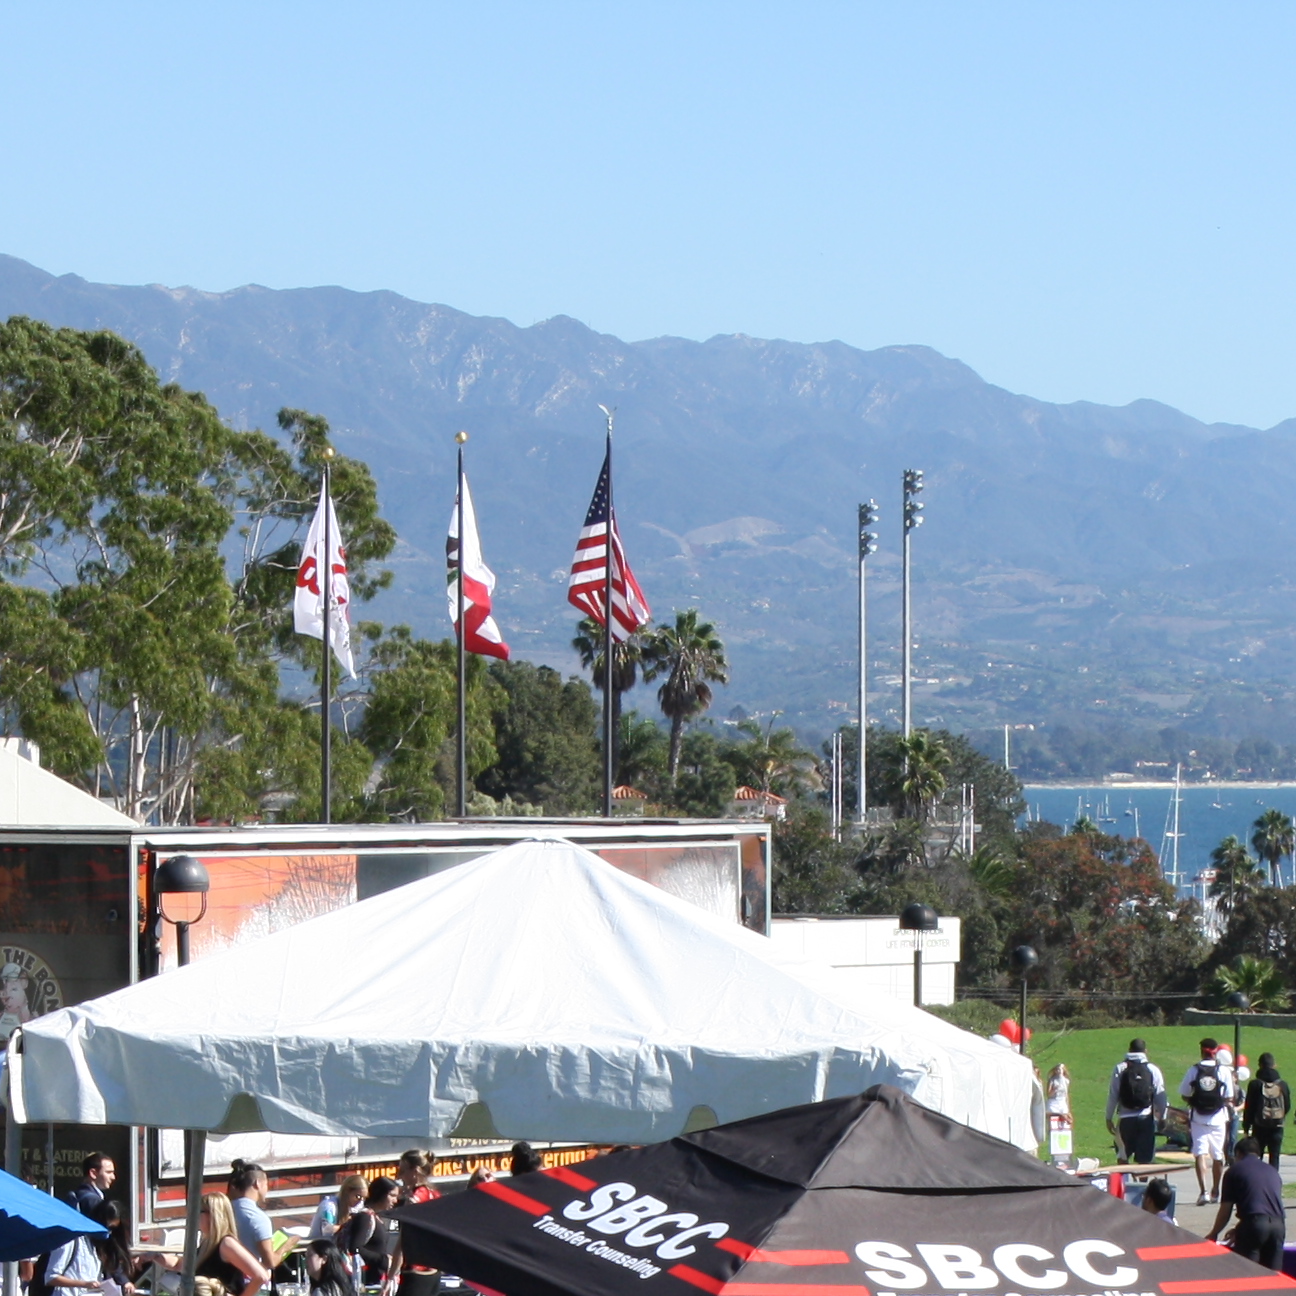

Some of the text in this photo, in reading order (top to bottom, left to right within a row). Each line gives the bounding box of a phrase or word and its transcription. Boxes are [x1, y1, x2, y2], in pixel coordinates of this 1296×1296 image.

[3, 948, 36, 971] THE
[35, 966, 62, 1012] BON
[533, 1215, 662, 1279] Transfer Counseling
[563, 1182, 730, 1260] SBCC
[855, 1239, 1139, 1289] SBCC
